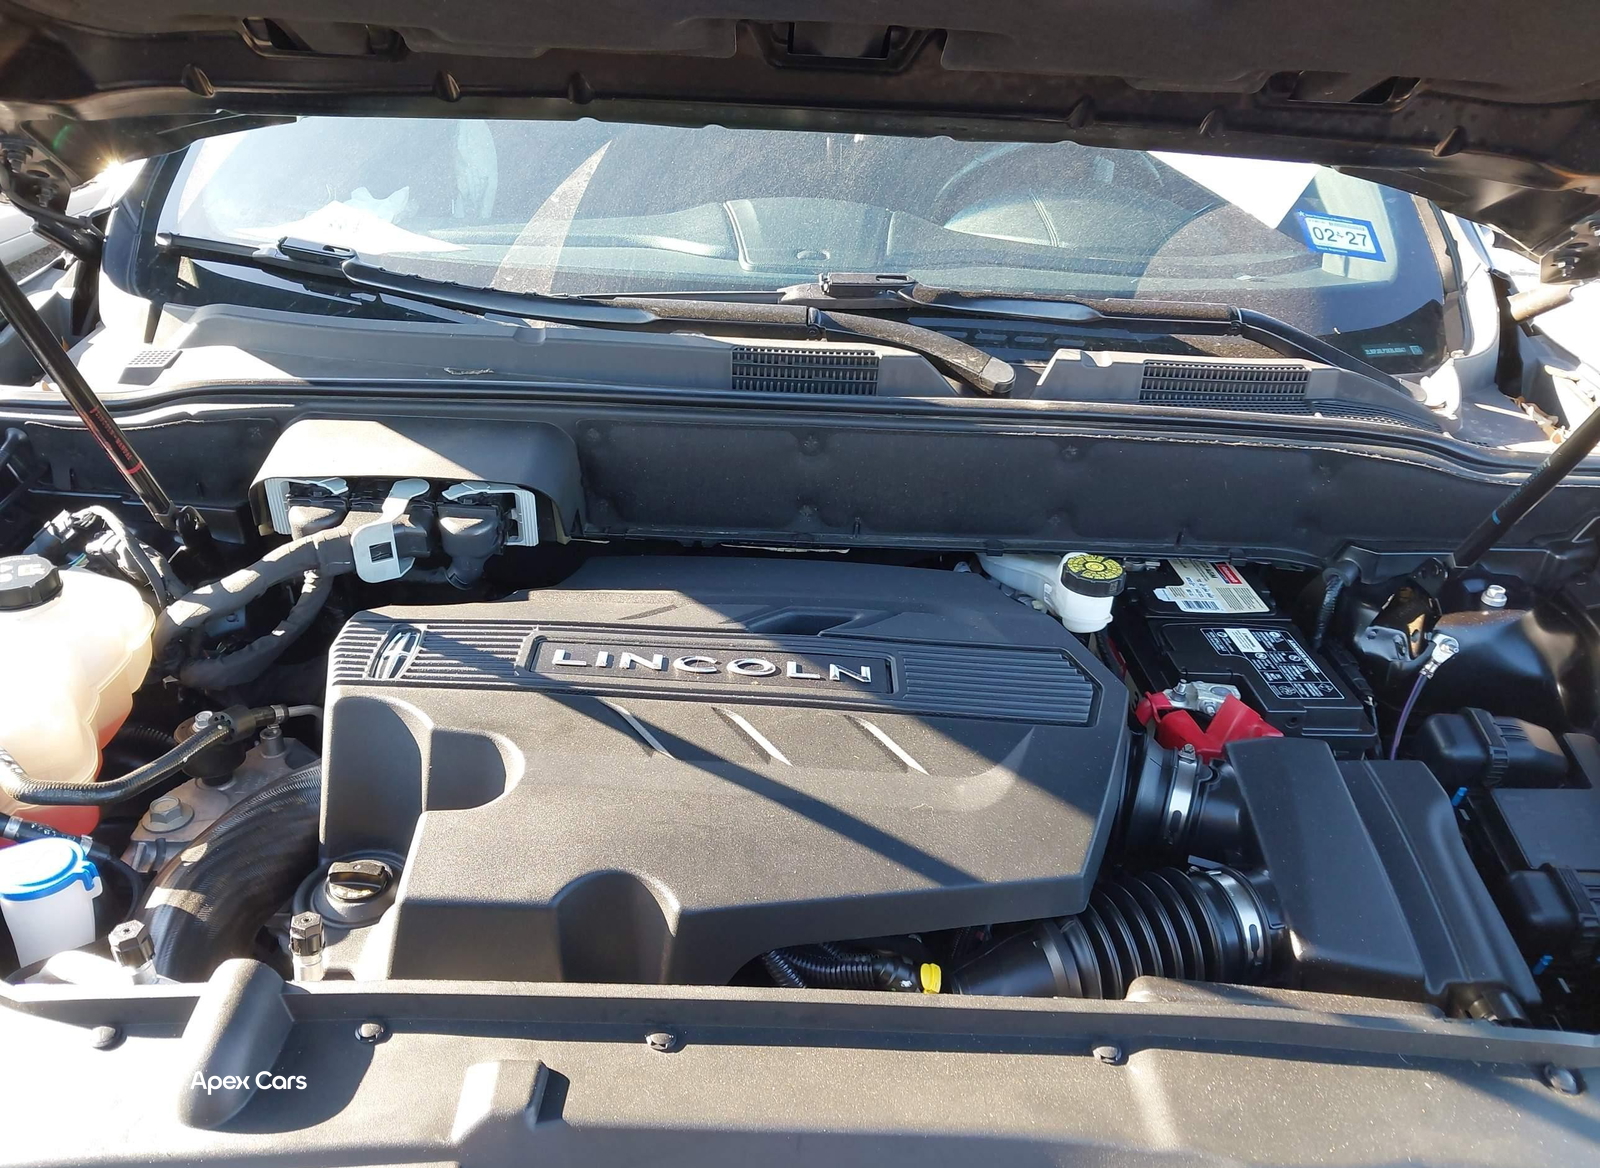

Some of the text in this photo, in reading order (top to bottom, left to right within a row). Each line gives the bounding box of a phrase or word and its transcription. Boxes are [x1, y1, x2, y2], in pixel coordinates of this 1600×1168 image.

[1312, 226, 1367, 246] 02 27
[552, 649, 871, 683] LINCOLN
